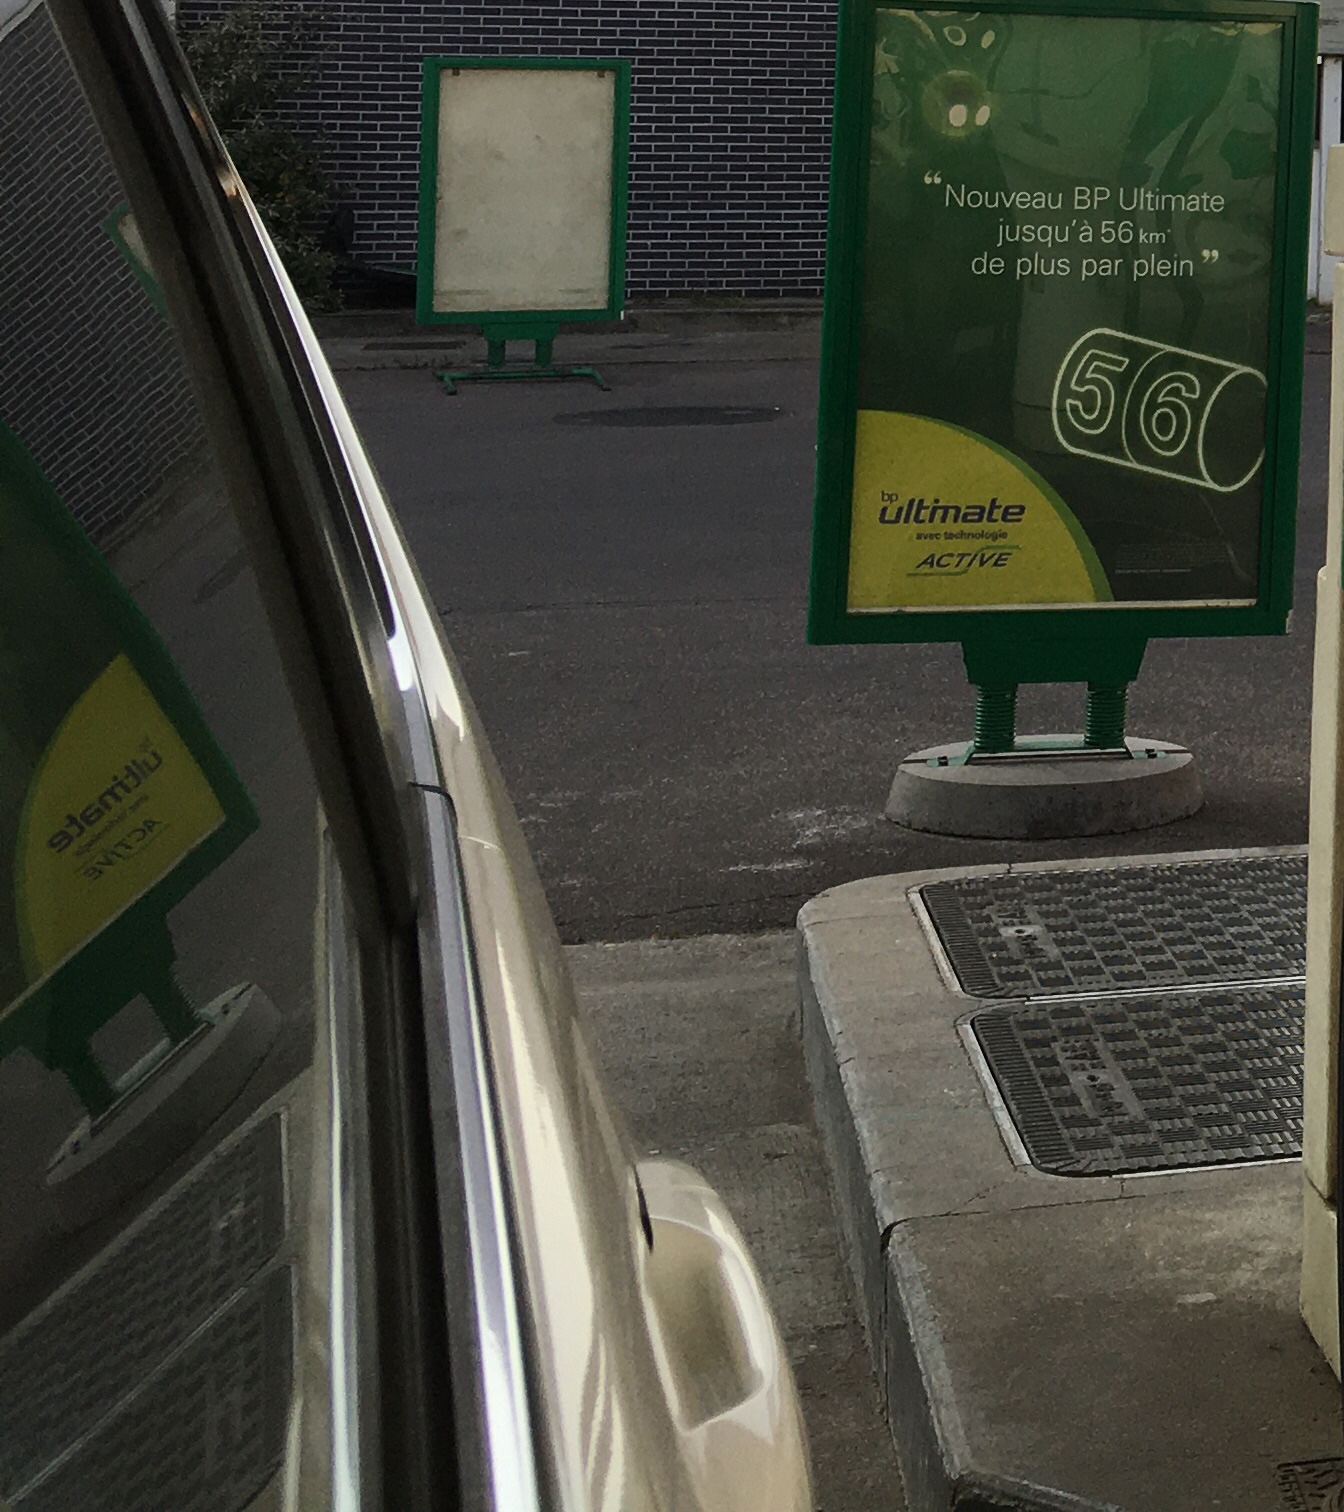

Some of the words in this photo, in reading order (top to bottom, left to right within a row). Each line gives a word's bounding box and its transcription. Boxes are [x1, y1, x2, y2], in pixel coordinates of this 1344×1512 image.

[1073, 187, 1111, 210] BP
[1118, 187, 1225, 213] Ultimate
[1100, 220, 1134, 244] 56
[970, 251, 1006, 275] de
[1015, 252, 1071, 280] plus
[1081, 257, 1124, 282] par
[880, 489, 899, 505] bp
[878, 496, 1026, 524] ultimate
[915, 531, 941, 541] avec
[943, 529, 1008, 542] technologie
[915, 551, 1014, 569] ACTIVE
